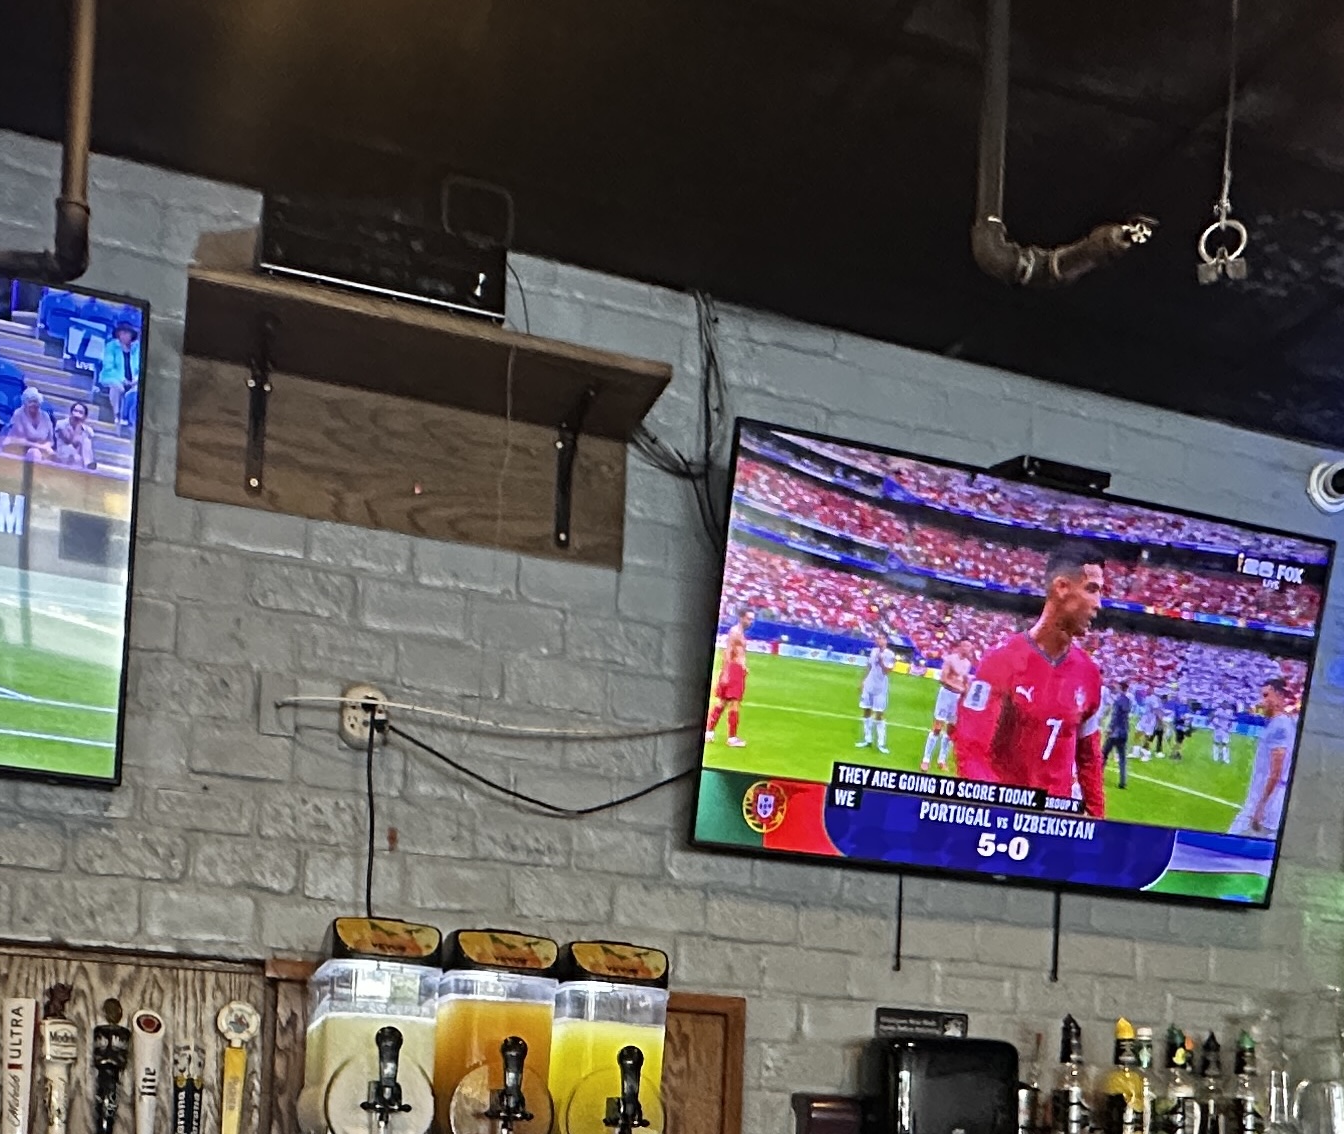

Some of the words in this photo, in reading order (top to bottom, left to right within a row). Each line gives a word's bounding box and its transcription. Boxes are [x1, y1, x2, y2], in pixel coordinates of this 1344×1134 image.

[1277, 564, 1304, 584] FOX
[1042, 717, 1064, 761] 7
[835, 788, 855, 807] WE
[838, 765, 868, 785] THEY
[871, 770, 896, 789] ARE
[899, 775, 936, 793] GOING
[940, 780, 955, 796] TO
[957, 782, 995, 802] SCORE
[999, 787, 1037, 807] TODAY.
[919, 802, 991, 828] PORTUGAL
[1013, 812, 1095, 840] UZBEKISTAN
[977, 832, 1029, 860] 5-0
[10, 1005, 25, 1060] ULTRA
